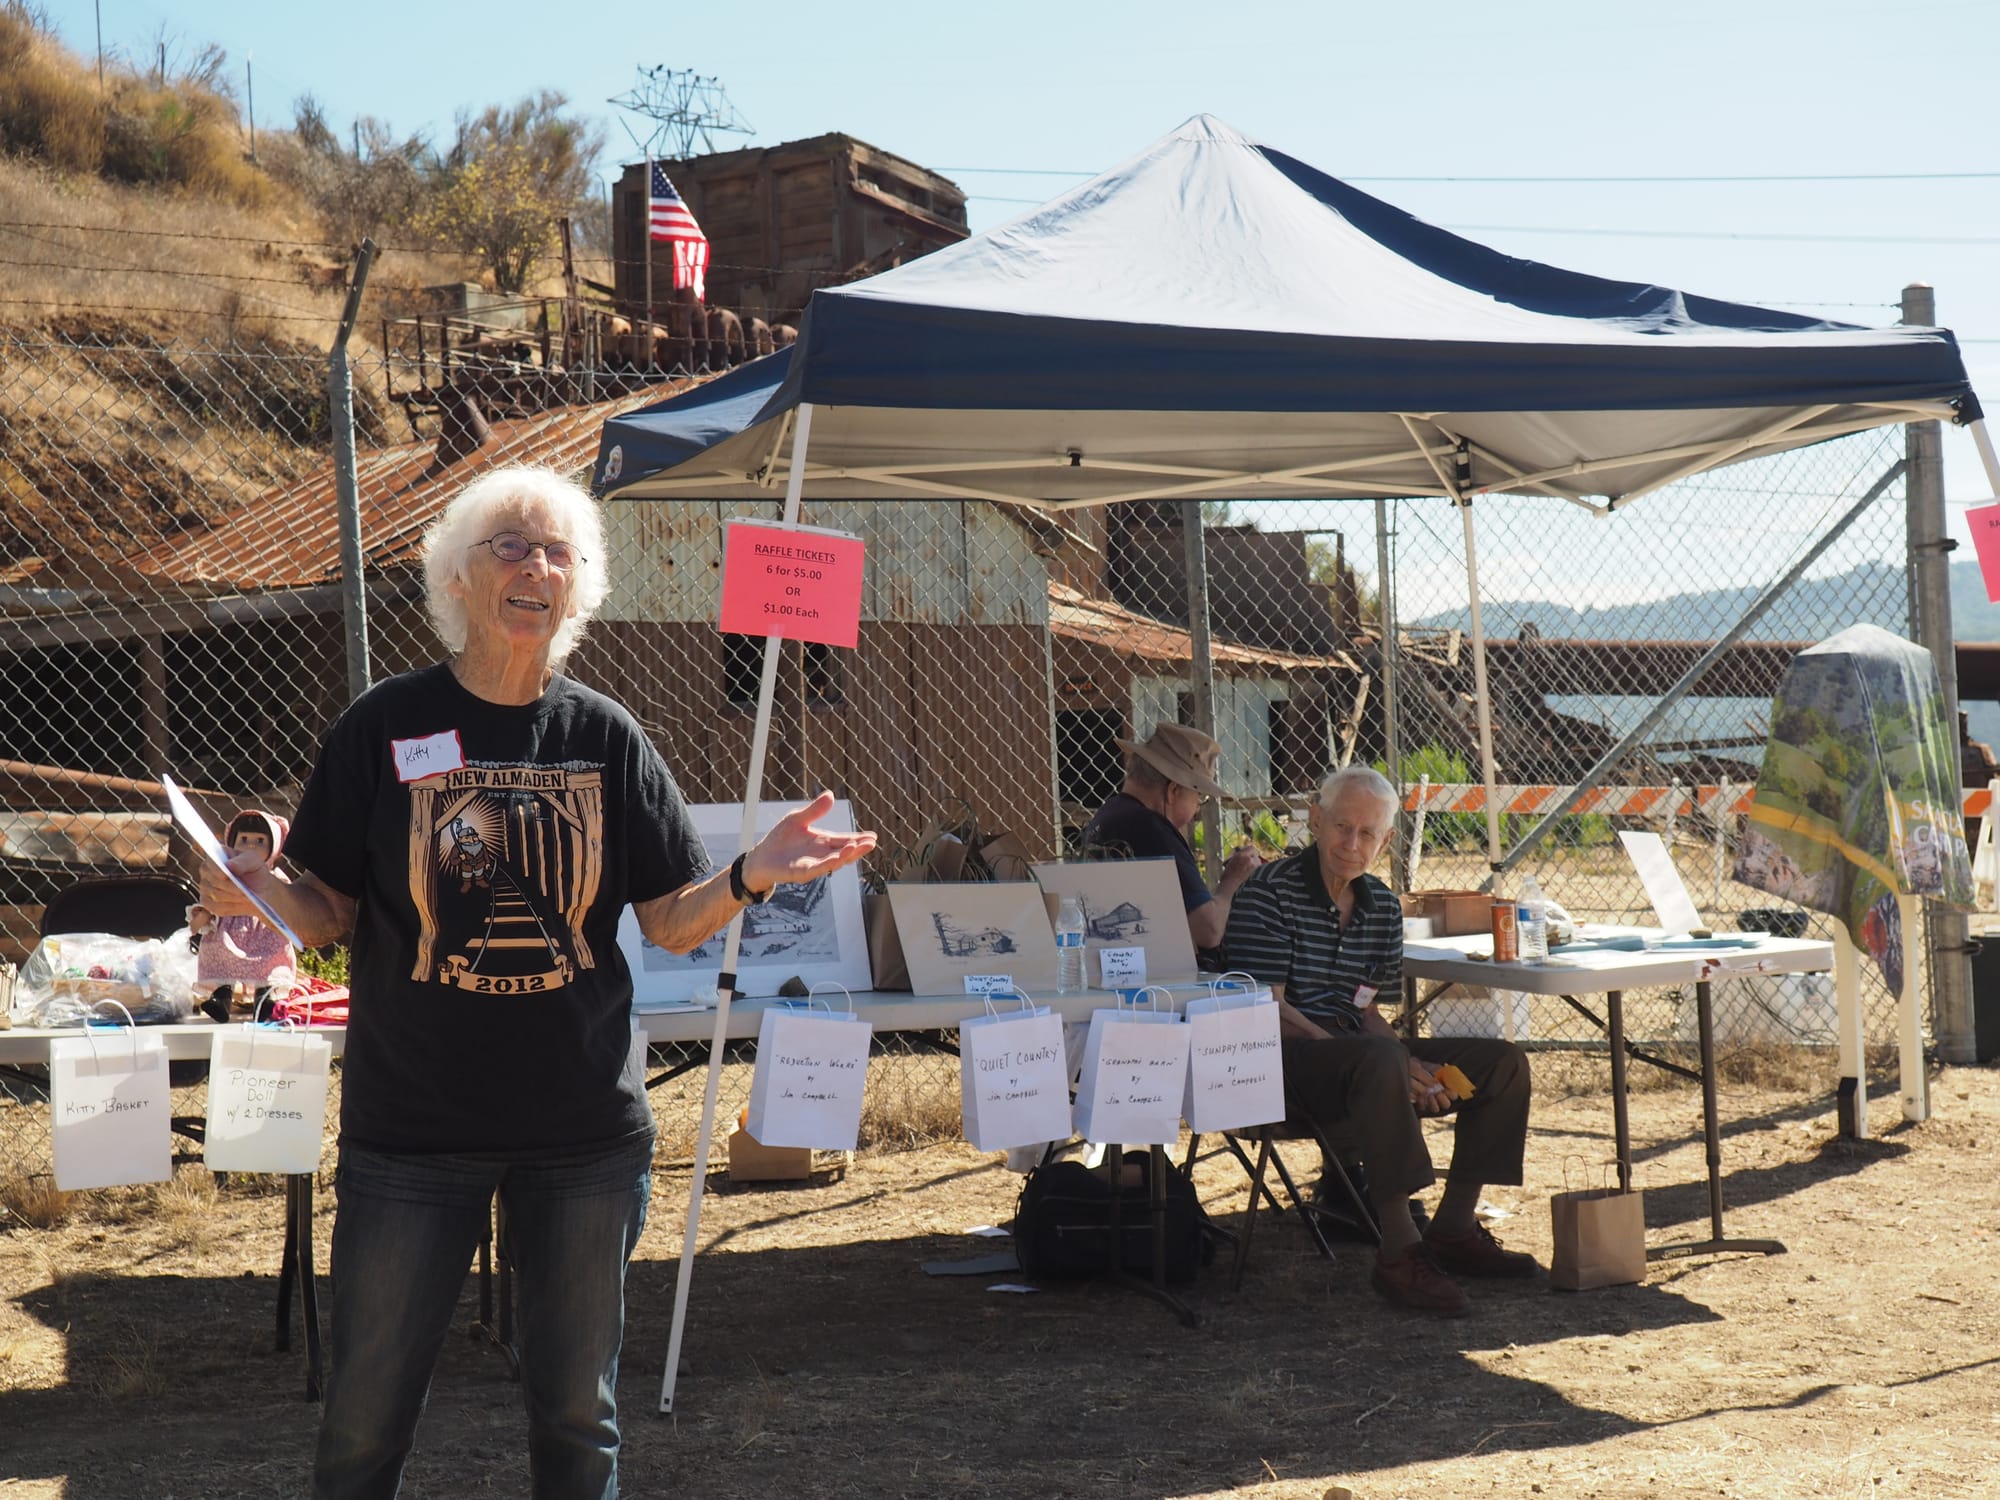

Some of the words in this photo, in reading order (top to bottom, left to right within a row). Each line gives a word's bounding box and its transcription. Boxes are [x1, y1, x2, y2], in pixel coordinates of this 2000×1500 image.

[754, 543, 793, 557] RAFFLE
[795, 548, 836, 563] TICKETS
[766, 565, 773, 574] 6
[775, 565, 791, 576] for
[793, 567, 822, 581] $5.00
[785, 586, 801, 597] OR
[763, 602, 793, 615] $1.00
[795, 606, 819, 619] Each
[404, 744, 430, 767] Kitty
[452, 771, 487, 787] NEW
[491, 771, 562, 788] ALMADEN
[475, 977, 546, 993] 2012
[228, 1069, 297, 1090] Pioneer
[247, 1088, 273, 1102] Doll
[102, 1097, 150, 1113] BASKET
[256, 1107, 303, 1120] Dresses
